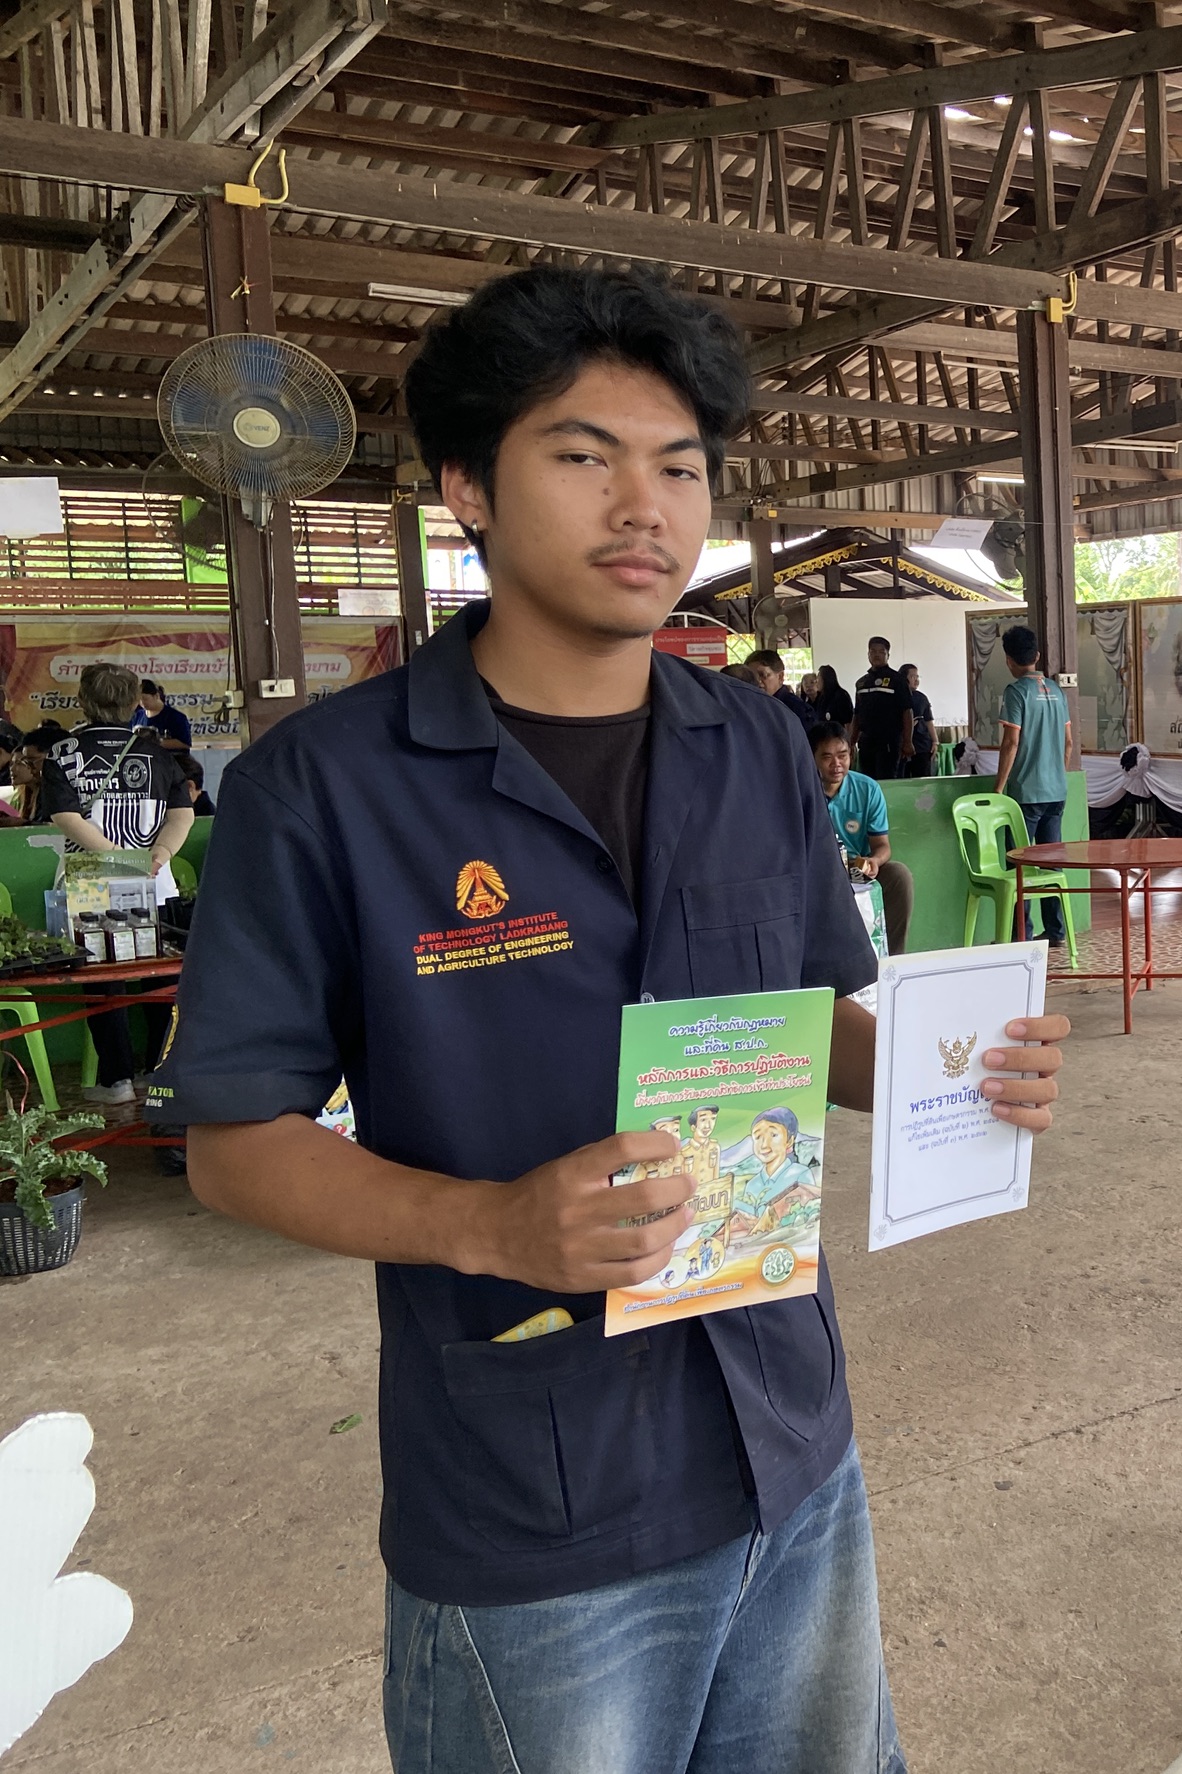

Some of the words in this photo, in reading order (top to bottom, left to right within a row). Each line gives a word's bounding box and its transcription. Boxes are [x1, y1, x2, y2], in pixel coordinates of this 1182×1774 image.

[413, 945, 426, 954] OF
[428, 933, 496, 951] TECHNOLOGY
[500, 921, 568, 940] LADKRABANG
[419, 932, 443, 943] KING
[446, 922, 505, 939] MONGKUT'S
[508, 912, 558, 928] INSTITUTE
[417, 954, 443, 965] DUAL
[445, 948, 486, 961] DEGREE
[488, 944, 502, 954] OF
[504, 931, 569, 951] ENGINEERING
[417, 966, 436, 976] AND
[437, 954, 506, 974] AGRICULTURE
[508, 941, 574, 961] TECHNOLOGY
[669, 1014, 785, 1037] ความรู้เกี่ยวกับกฎหมาย
[685, 1036, 729, 1056] และที่ดิน
[734, 1038, 767, 1051] ส.ป.ก.
[638, 1053, 811, 1085] หลักการและวิธีการปฏิบัติงาน
